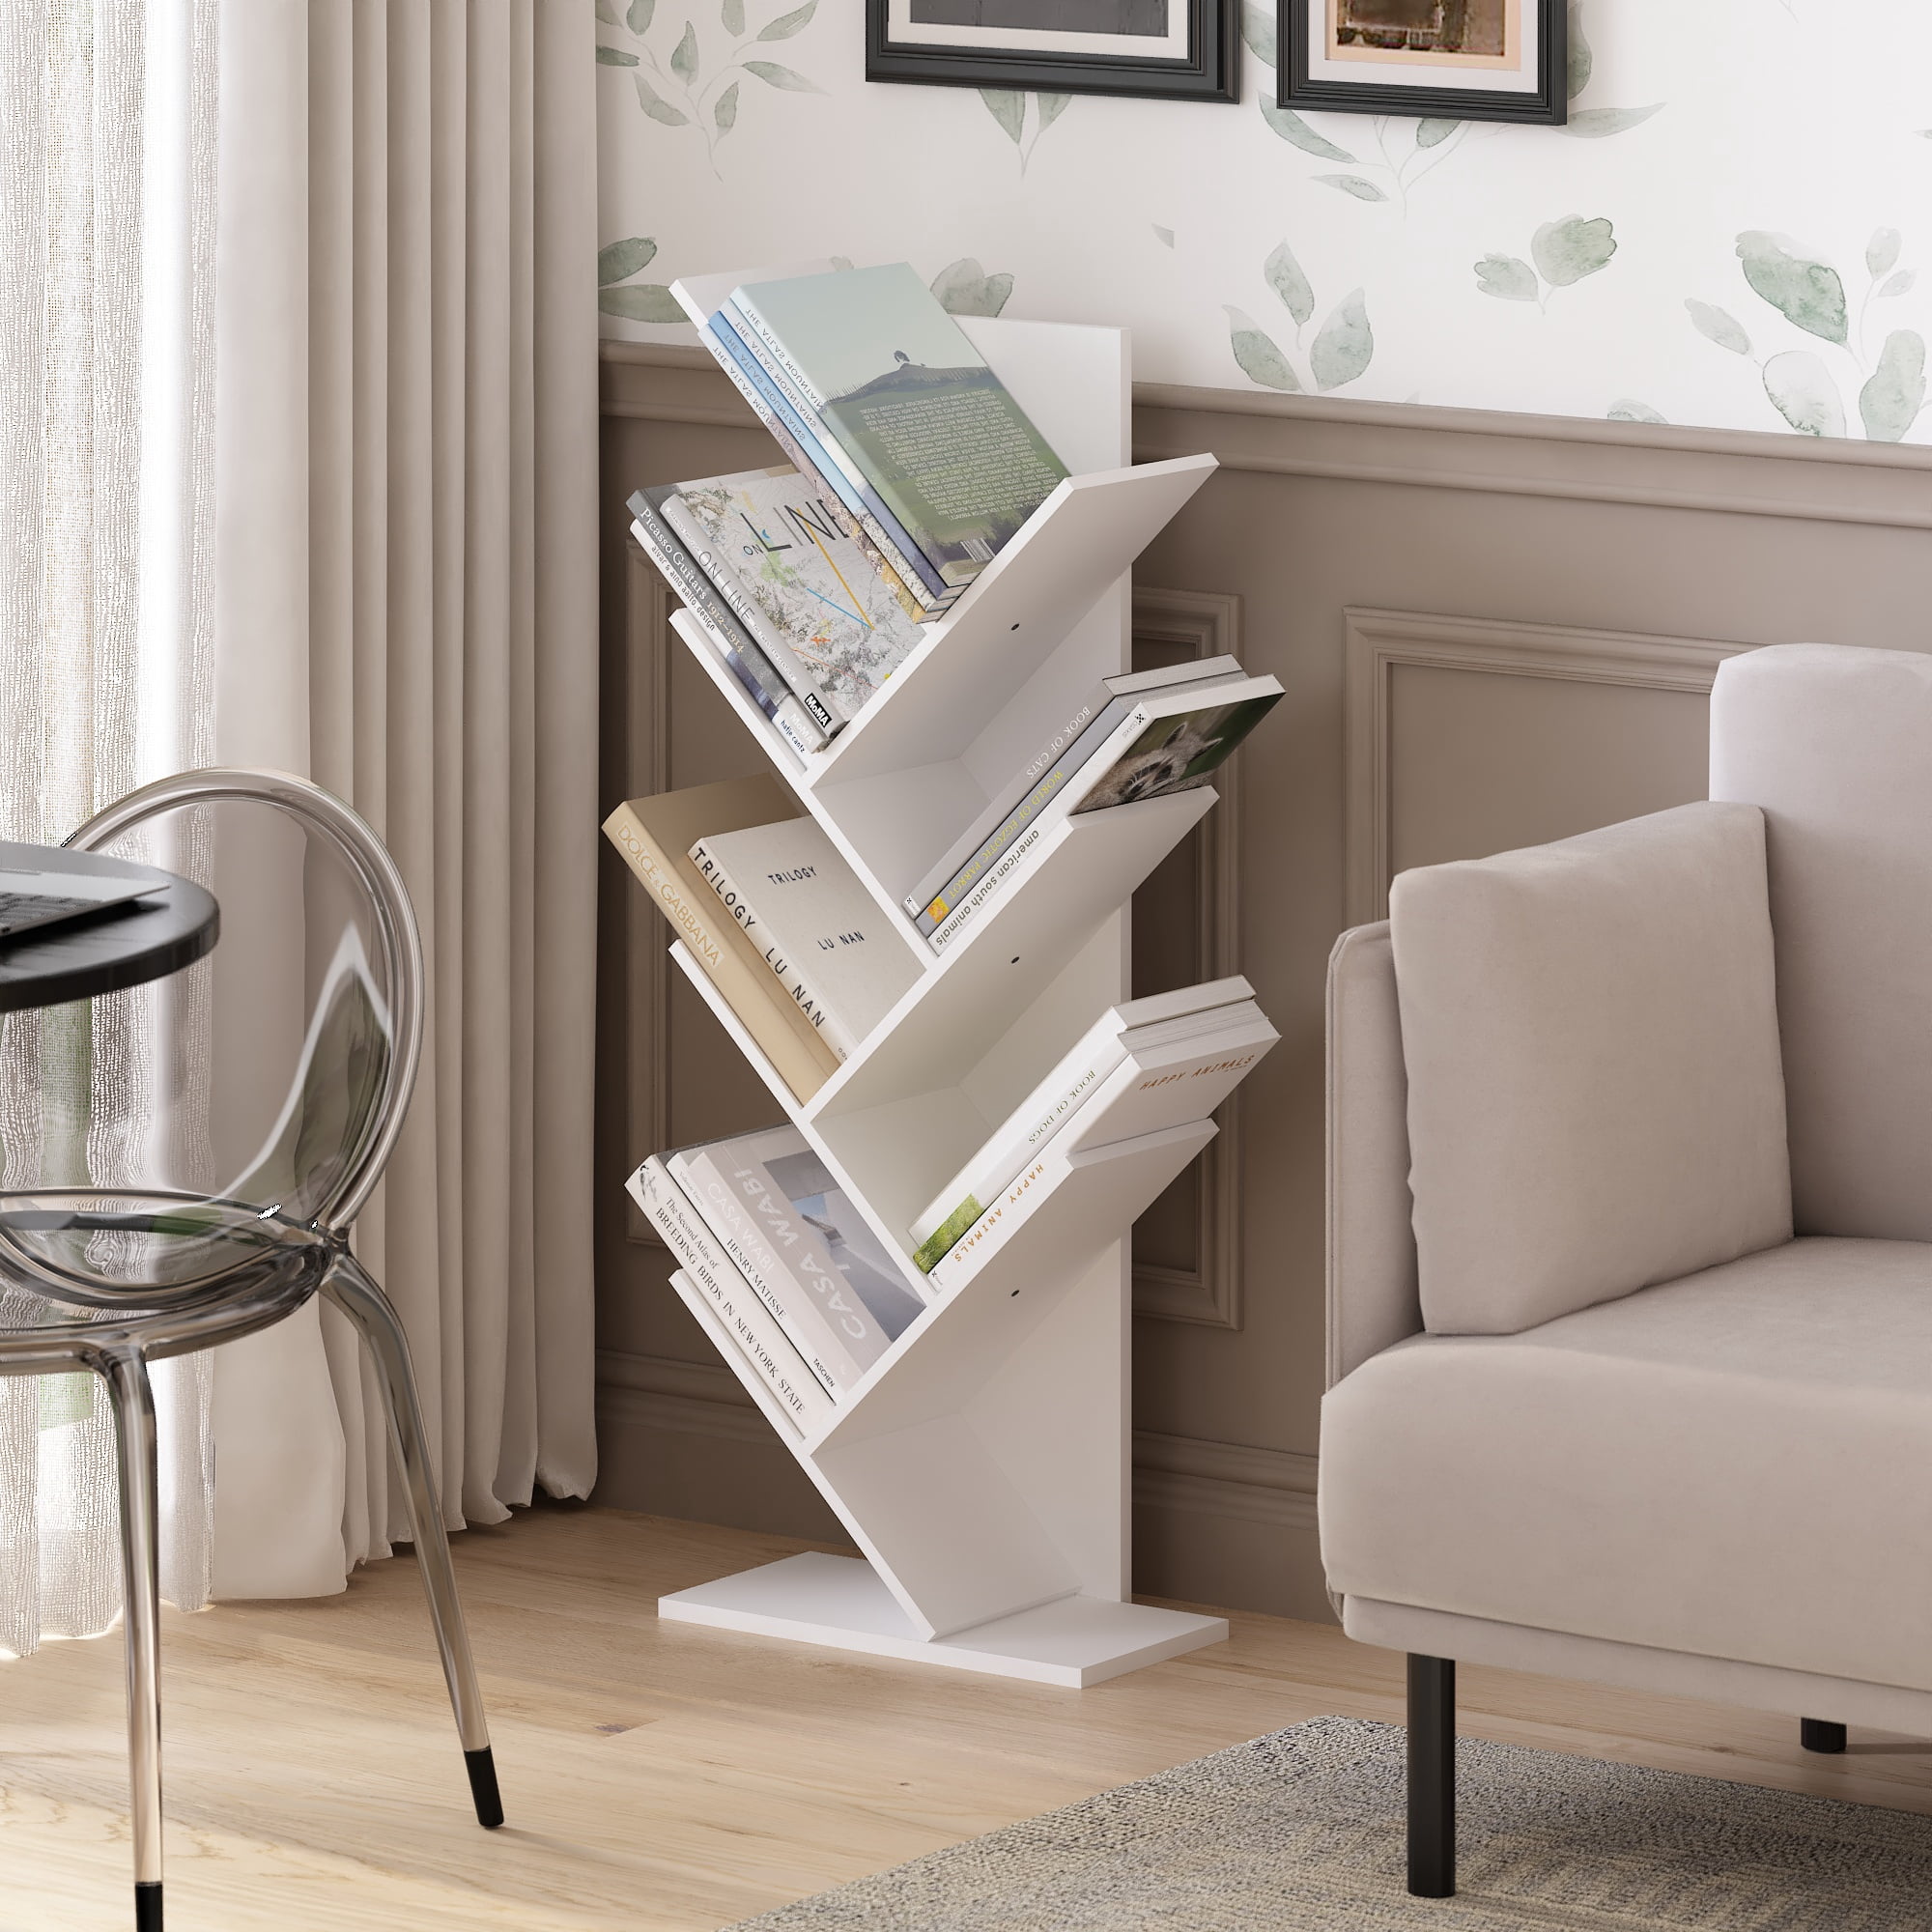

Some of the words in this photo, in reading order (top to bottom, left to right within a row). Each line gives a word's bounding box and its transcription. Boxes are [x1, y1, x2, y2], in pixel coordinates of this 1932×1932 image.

[639, 506, 673, 554] Picasso
[672, 552, 707, 600] Guitars
[743, 543, 765, 556] ON
[651, 545, 668, 566] alvar
[670, 570, 682, 587] aino
[696, 607, 715, 632] design
[699, 551, 723, 581] ON
[723, 580, 755, 622] LINE
[790, 713, 813, 744] MoMA
[806, 694, 831, 728] MoMA
[1063, 705, 1091, 738] BOOK
[781, 720, 793, 737] hatje
[792, 736, 806, 753] cantz
[1050, 736, 1064, 753] OF
[1026, 752, 1049, 779] CATS
[1031, 771, 1064, 806] WORLD
[1019, 806, 1032, 821] OF
[997, 830, 1039, 878] american
[768, 866, 816, 885] TRILOGY
[949, 862, 981, 900] PARROT
[971, 877, 998, 907] south
[617, 825, 659, 880] DOLCE
[661, 883, 721, 966] GABBANA
[694, 847, 755, 929] TRILOGY
[765, 948, 788, 974] LU
[792, 984, 825, 1028] NAN
[817, 939, 835, 951] LU
[838, 931, 865, 945] NAN
[936, 908, 972, 945] animals
[1069, 1070, 1095, 1099] BOOK
[1140, 1072, 1186, 1090] HAPPY
[1191, 1055, 1254, 1078] ANIMALS
[1056, 1099, 1068, 1115] OF
[1028, 1115, 1055, 1144] DOGS
[1009, 1164, 1044, 1204] HAPPY
[734, 1169, 800, 1247] WABI
[665, 1196, 678, 1214] The
[676, 1211, 697, 1242] Second
[696, 1238, 709, 1260] Atlas
[709, 1259, 721, 1269] of
[707, 1182, 740, 1231] CASA
[742, 1228, 775, 1273] WABI
[954, 1208, 1003, 1262] ANIMALS
[726, 1238, 755, 1279] HENRY
[752, 1273, 786, 1320] MATISSE
[799, 1252, 867, 1339] CASA
[655, 1208, 697, 1265] BREEDING
[697, 1265, 724, 1301] BIRDS
[723, 1301, 736, 1318] IN
[734, 1318, 757, 1345] NEW
[753, 1343, 780, 1378] YORK
[779, 1379, 806, 1415] STATE
[813, 1358, 835, 1388] TASCHEN
